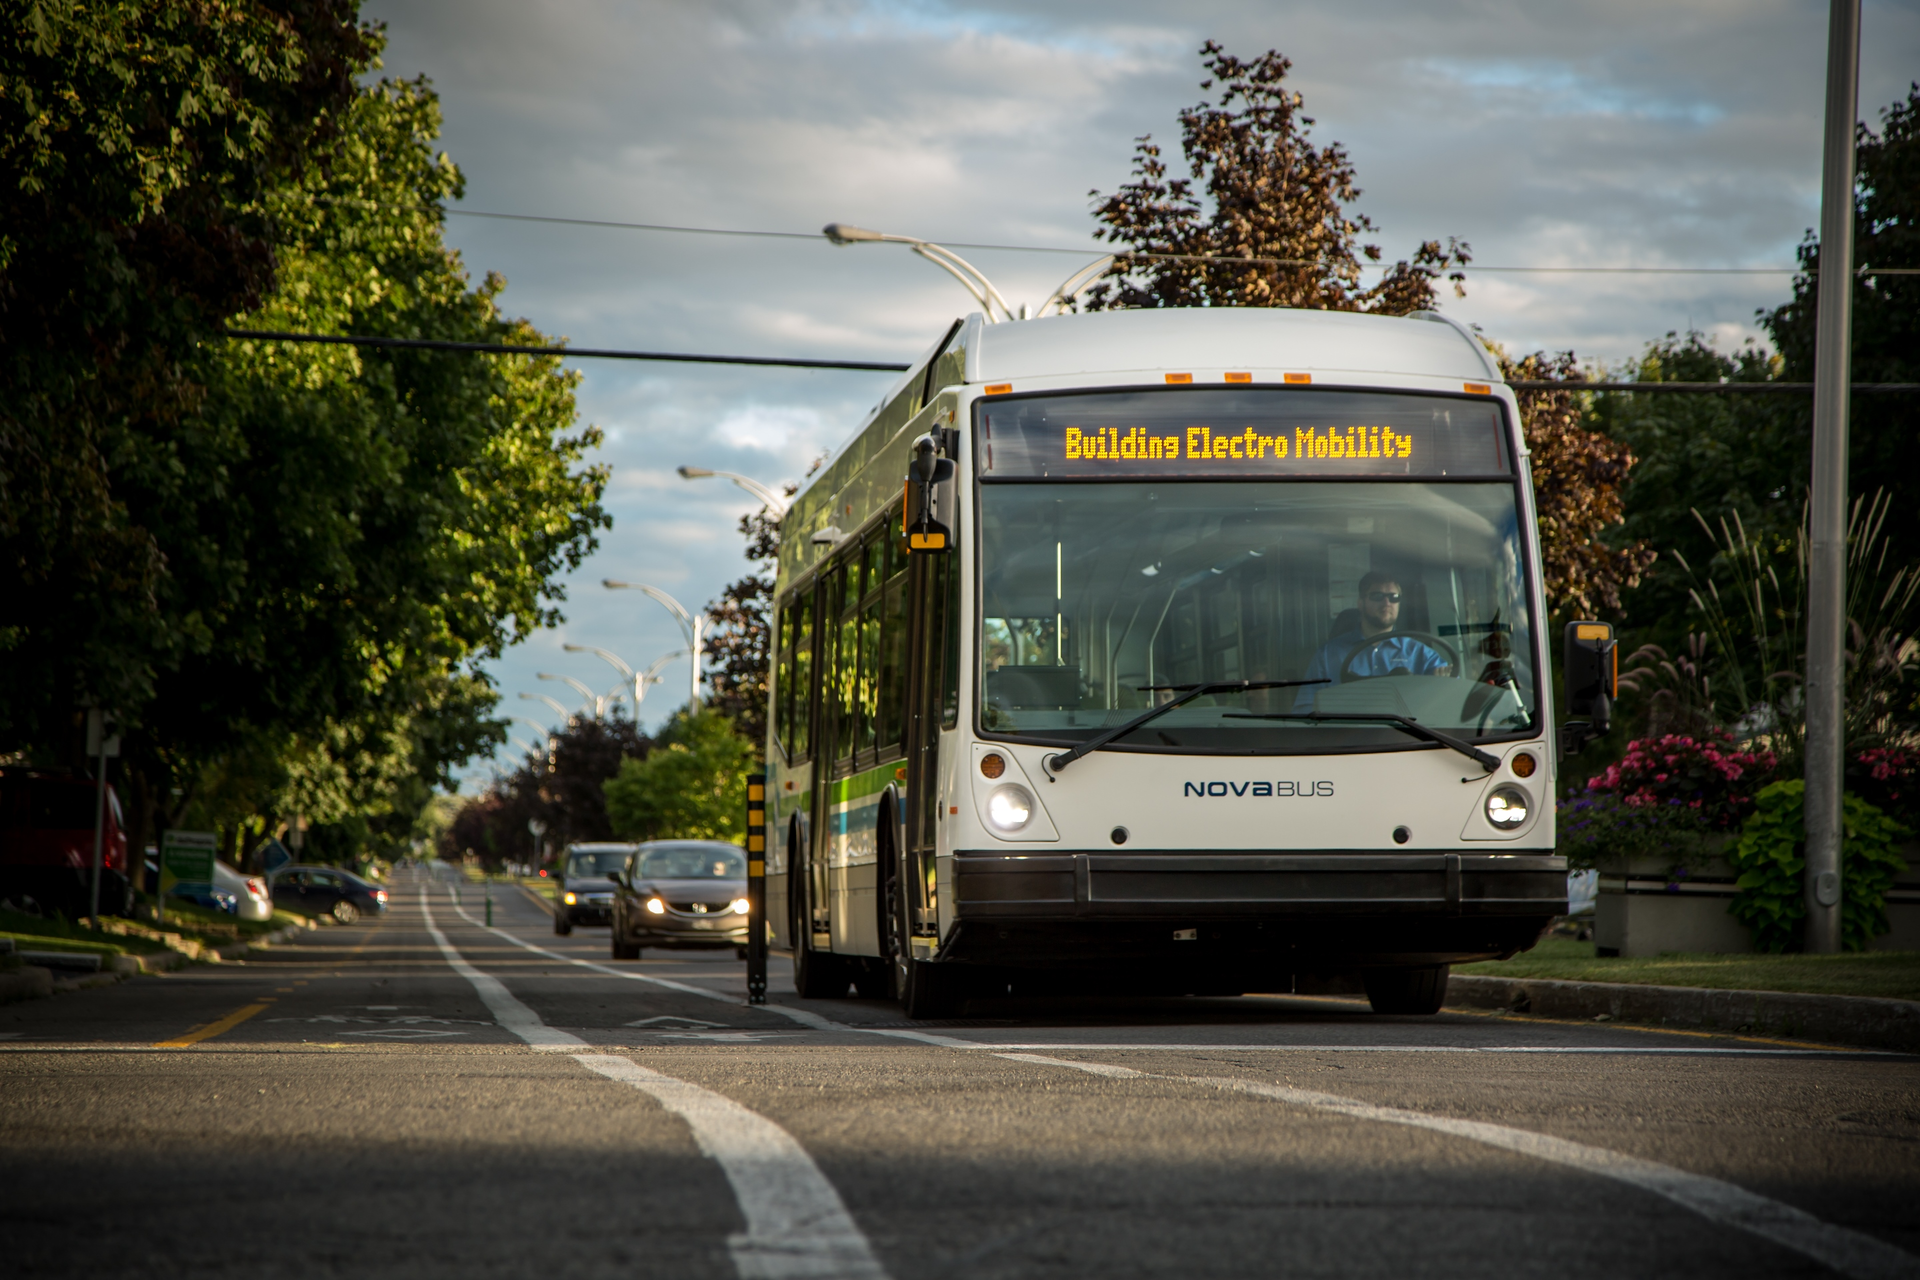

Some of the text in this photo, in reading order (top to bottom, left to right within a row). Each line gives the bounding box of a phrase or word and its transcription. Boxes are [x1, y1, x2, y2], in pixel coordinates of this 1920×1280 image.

[1066, 426, 1411, 459] Building Electro Mobility
